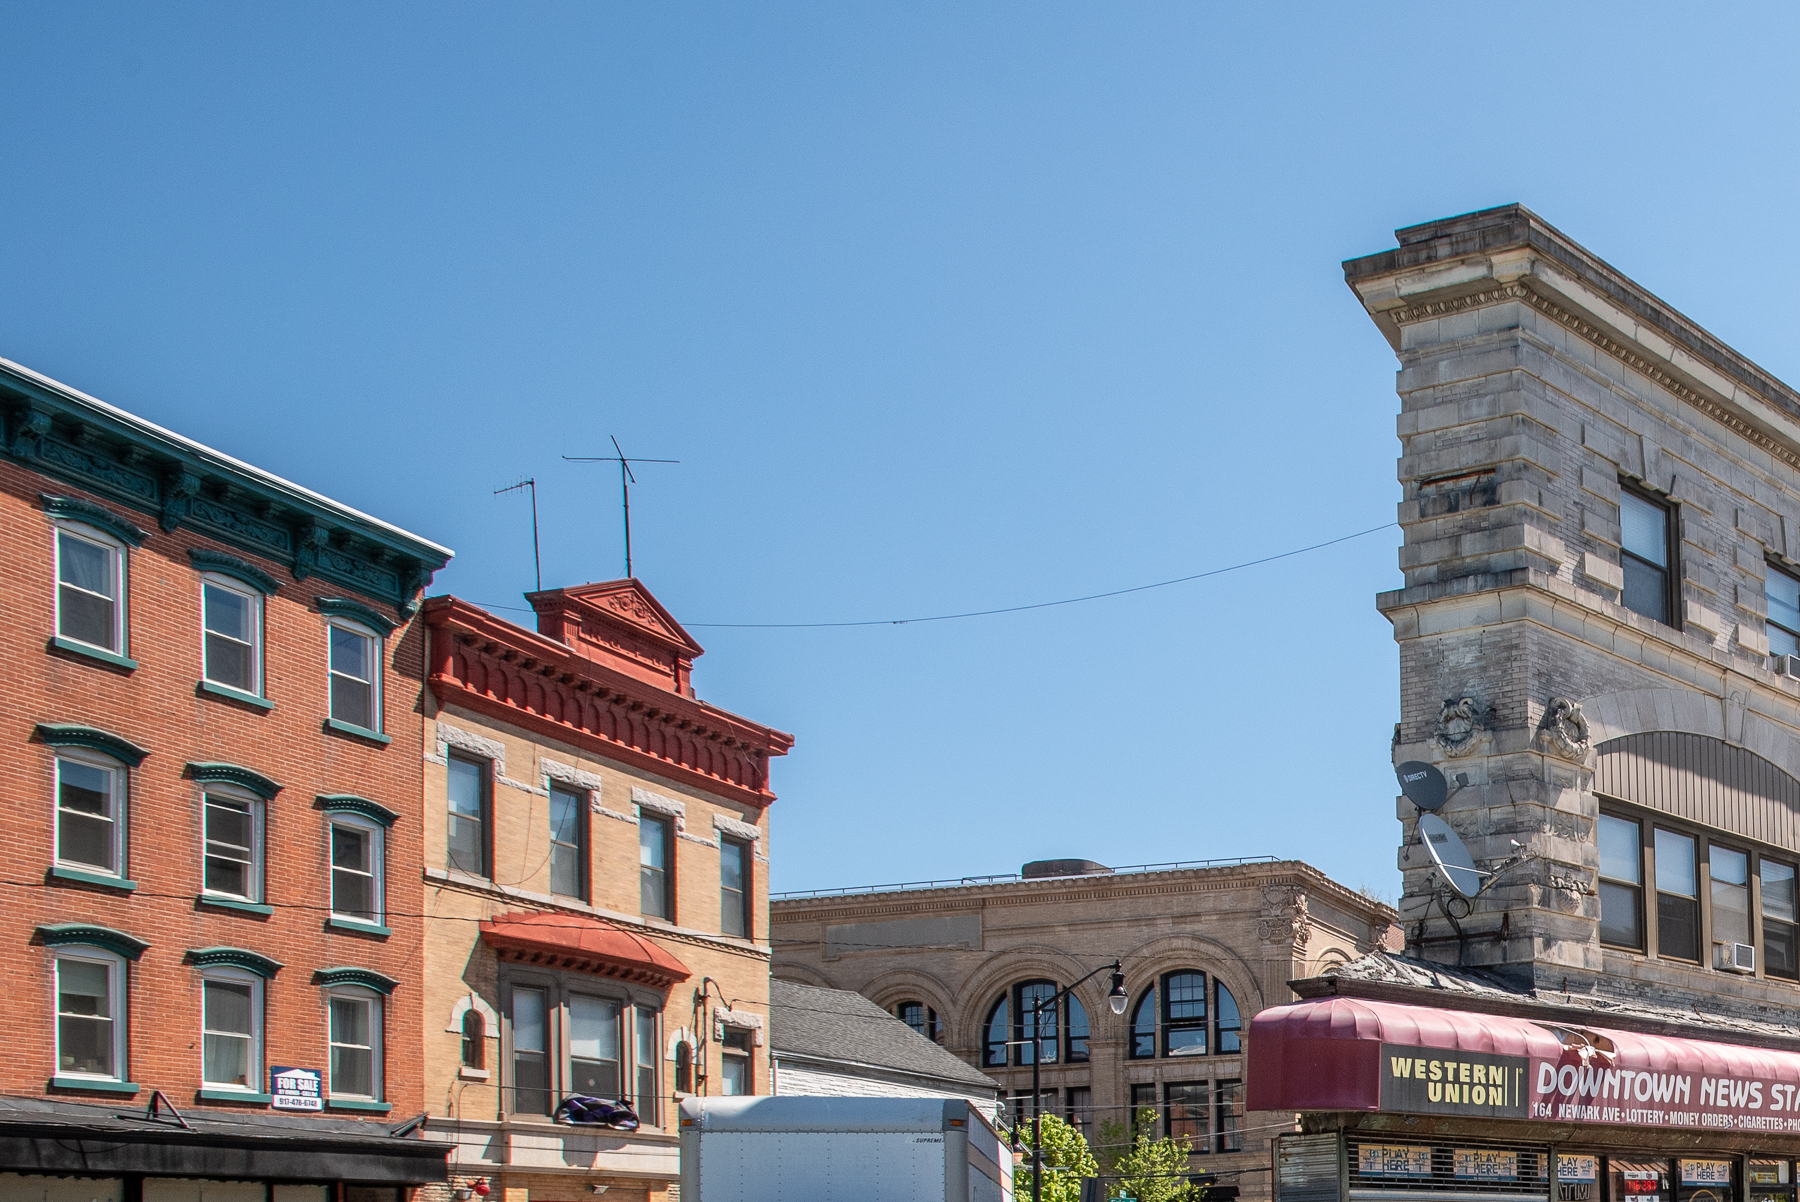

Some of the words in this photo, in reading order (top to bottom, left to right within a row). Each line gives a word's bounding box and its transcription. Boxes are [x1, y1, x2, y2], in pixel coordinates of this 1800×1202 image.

[1407, 770, 1428, 782] DIRECTV
[1390, 1056, 1503, 1085] WESTERN
[278, 1078, 296, 1090] FOR
[297, 1079, 318, 1091] SALE
[1536, 1062, 1691, 1104] DOWNTOWN
[1700, 1076, 1763, 1109] NEWS
[1428, 1082, 1503, 1106] UNION
[1533, 1102, 1552, 1118] 164
[1558, 1104, 1600, 1120] NEWARK
[1602, 1106, 1620, 1121] AVE
[1626, 1108, 1664, 1124] LOTTERY
[1670, 1111, 1700, 1126] MONEY
[1702, 1114, 1733, 1128] ORDERS
[1738, 1116, 1784, 1130] CIGARETTES
[1383, 1148, 1410, 1158] PLAY
[1473, 1152, 1498, 1163] PLAY
[1384, 1160, 1410, 1171] HERE
[1474, 1163, 1499, 1174] HERE
[1696, 1162, 1715, 1171] PLAY
[1696, 1171, 1715, 1180] HERE
